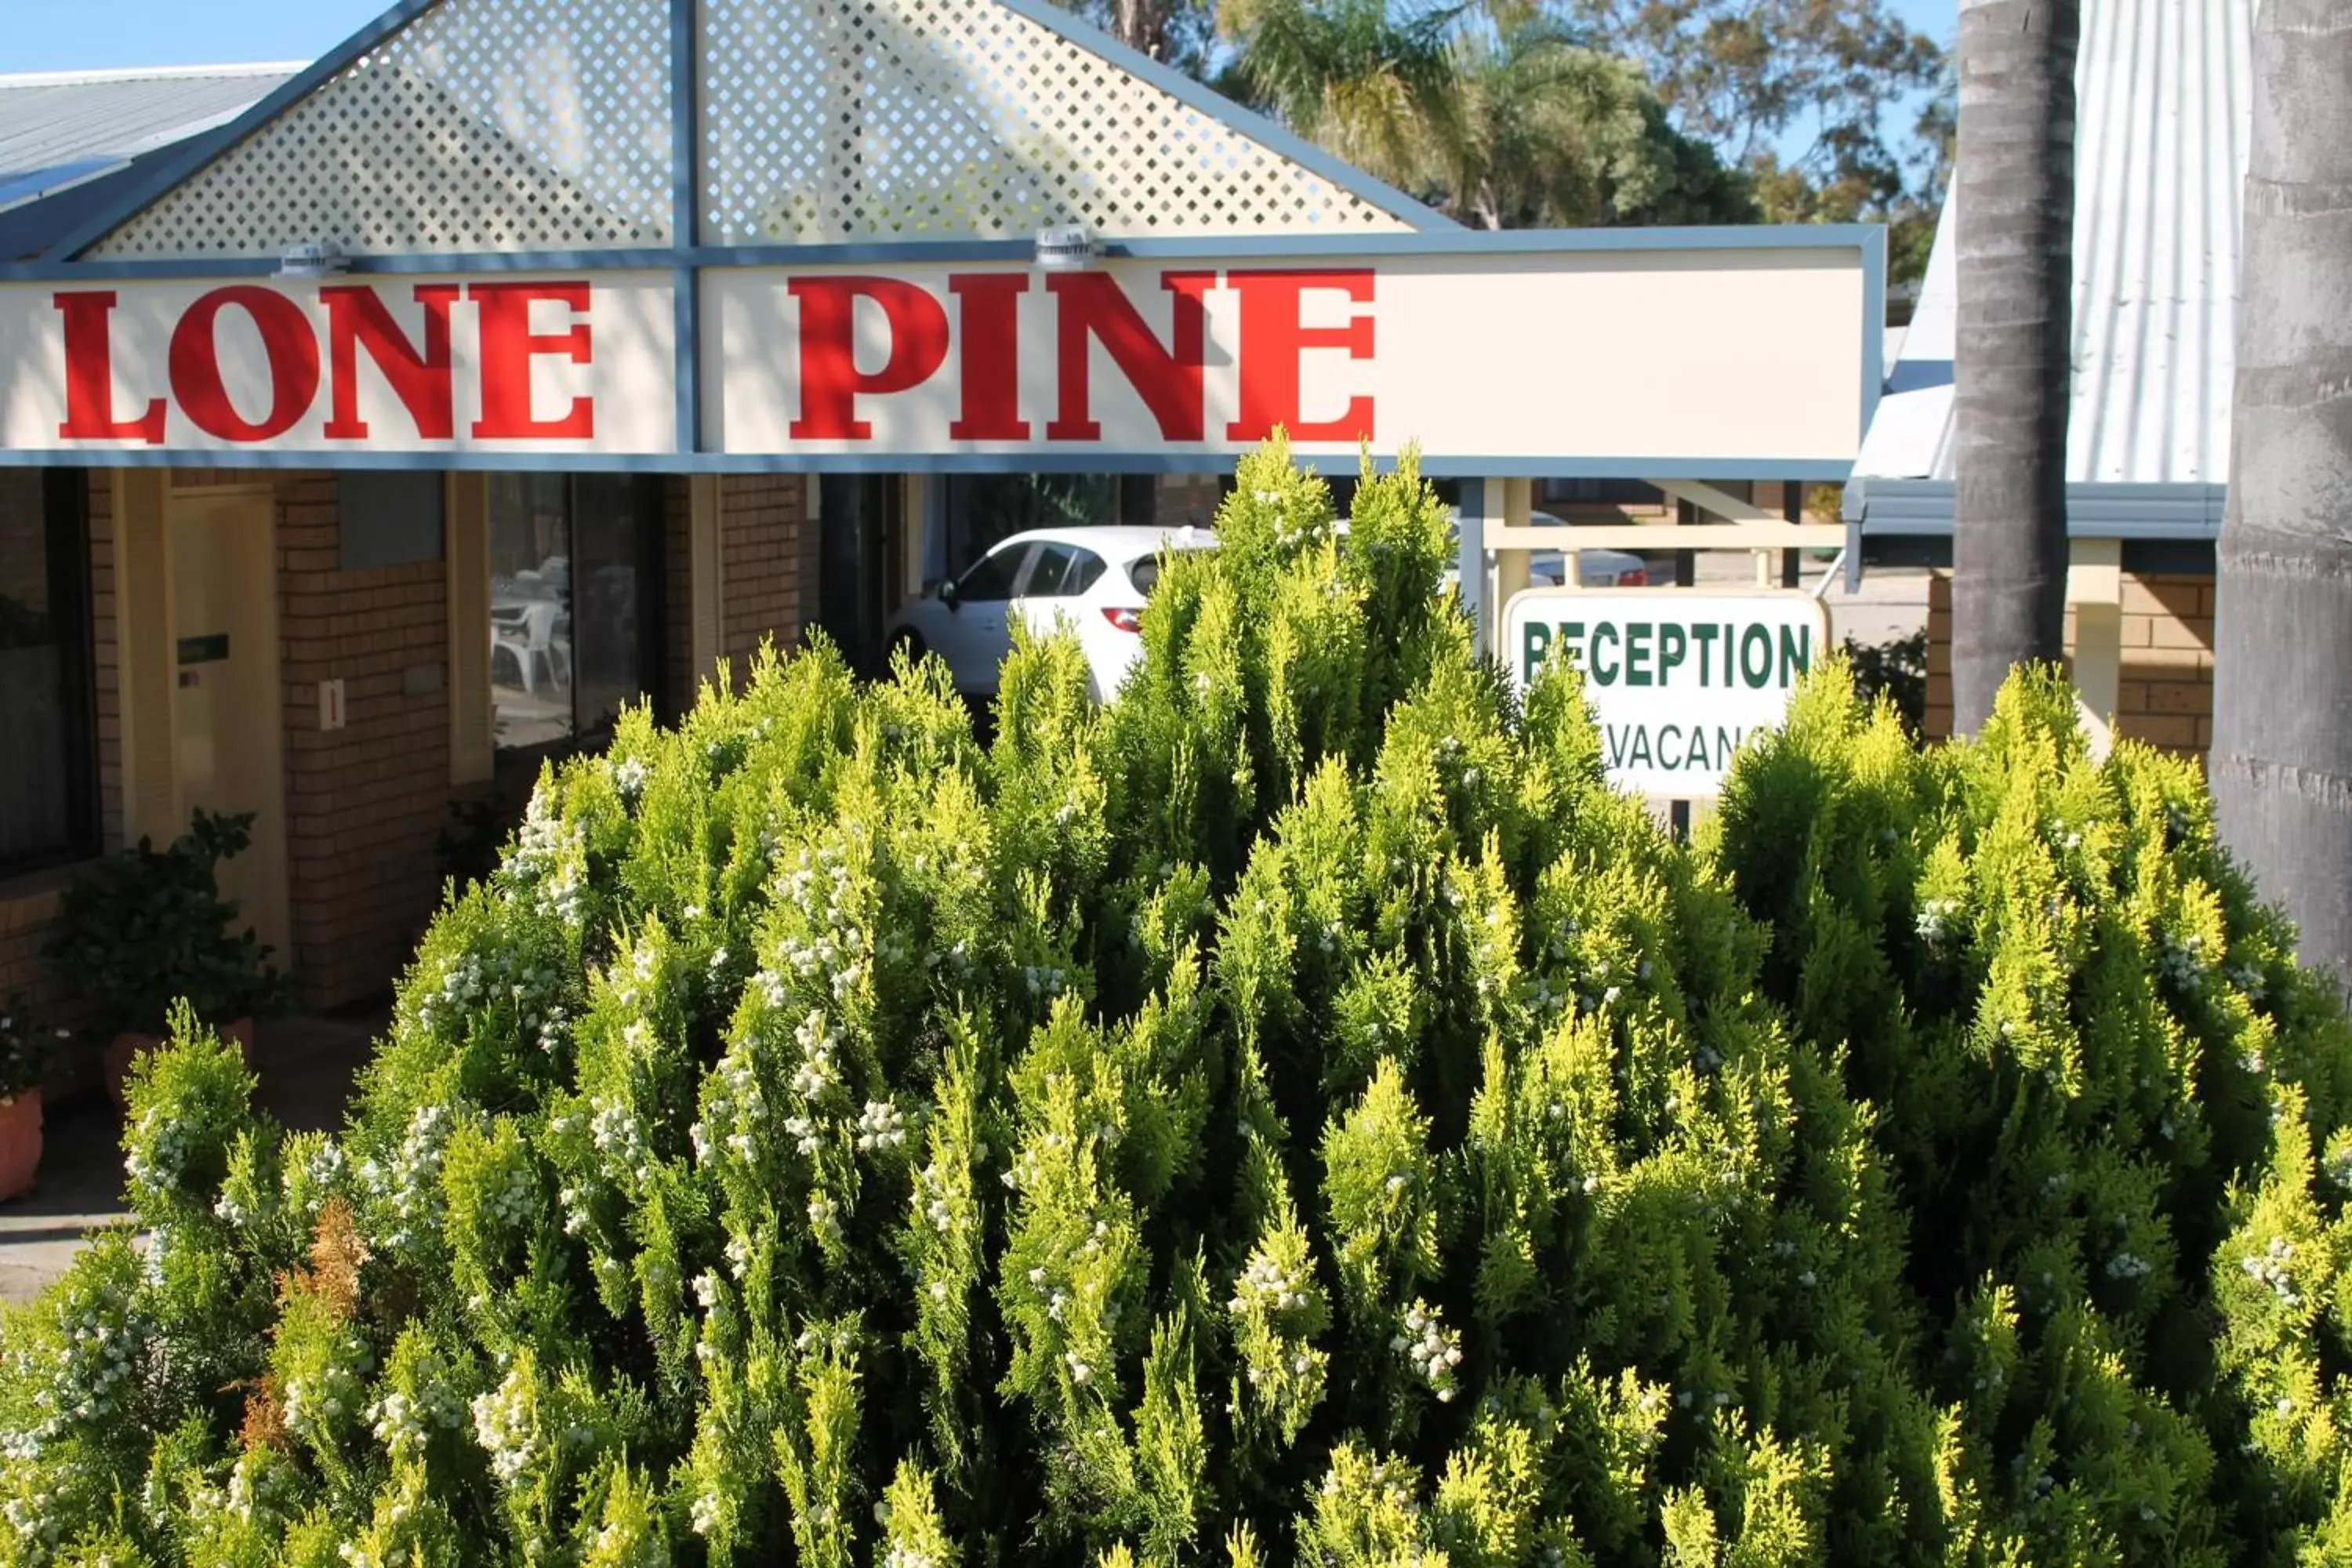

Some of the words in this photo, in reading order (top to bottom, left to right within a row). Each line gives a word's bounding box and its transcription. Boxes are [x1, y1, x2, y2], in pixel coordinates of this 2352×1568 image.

[53, 281, 596, 445] LONE
[787, 268, 1376, 442] PINE
[1606, 723, 1782, 771] VACAN
